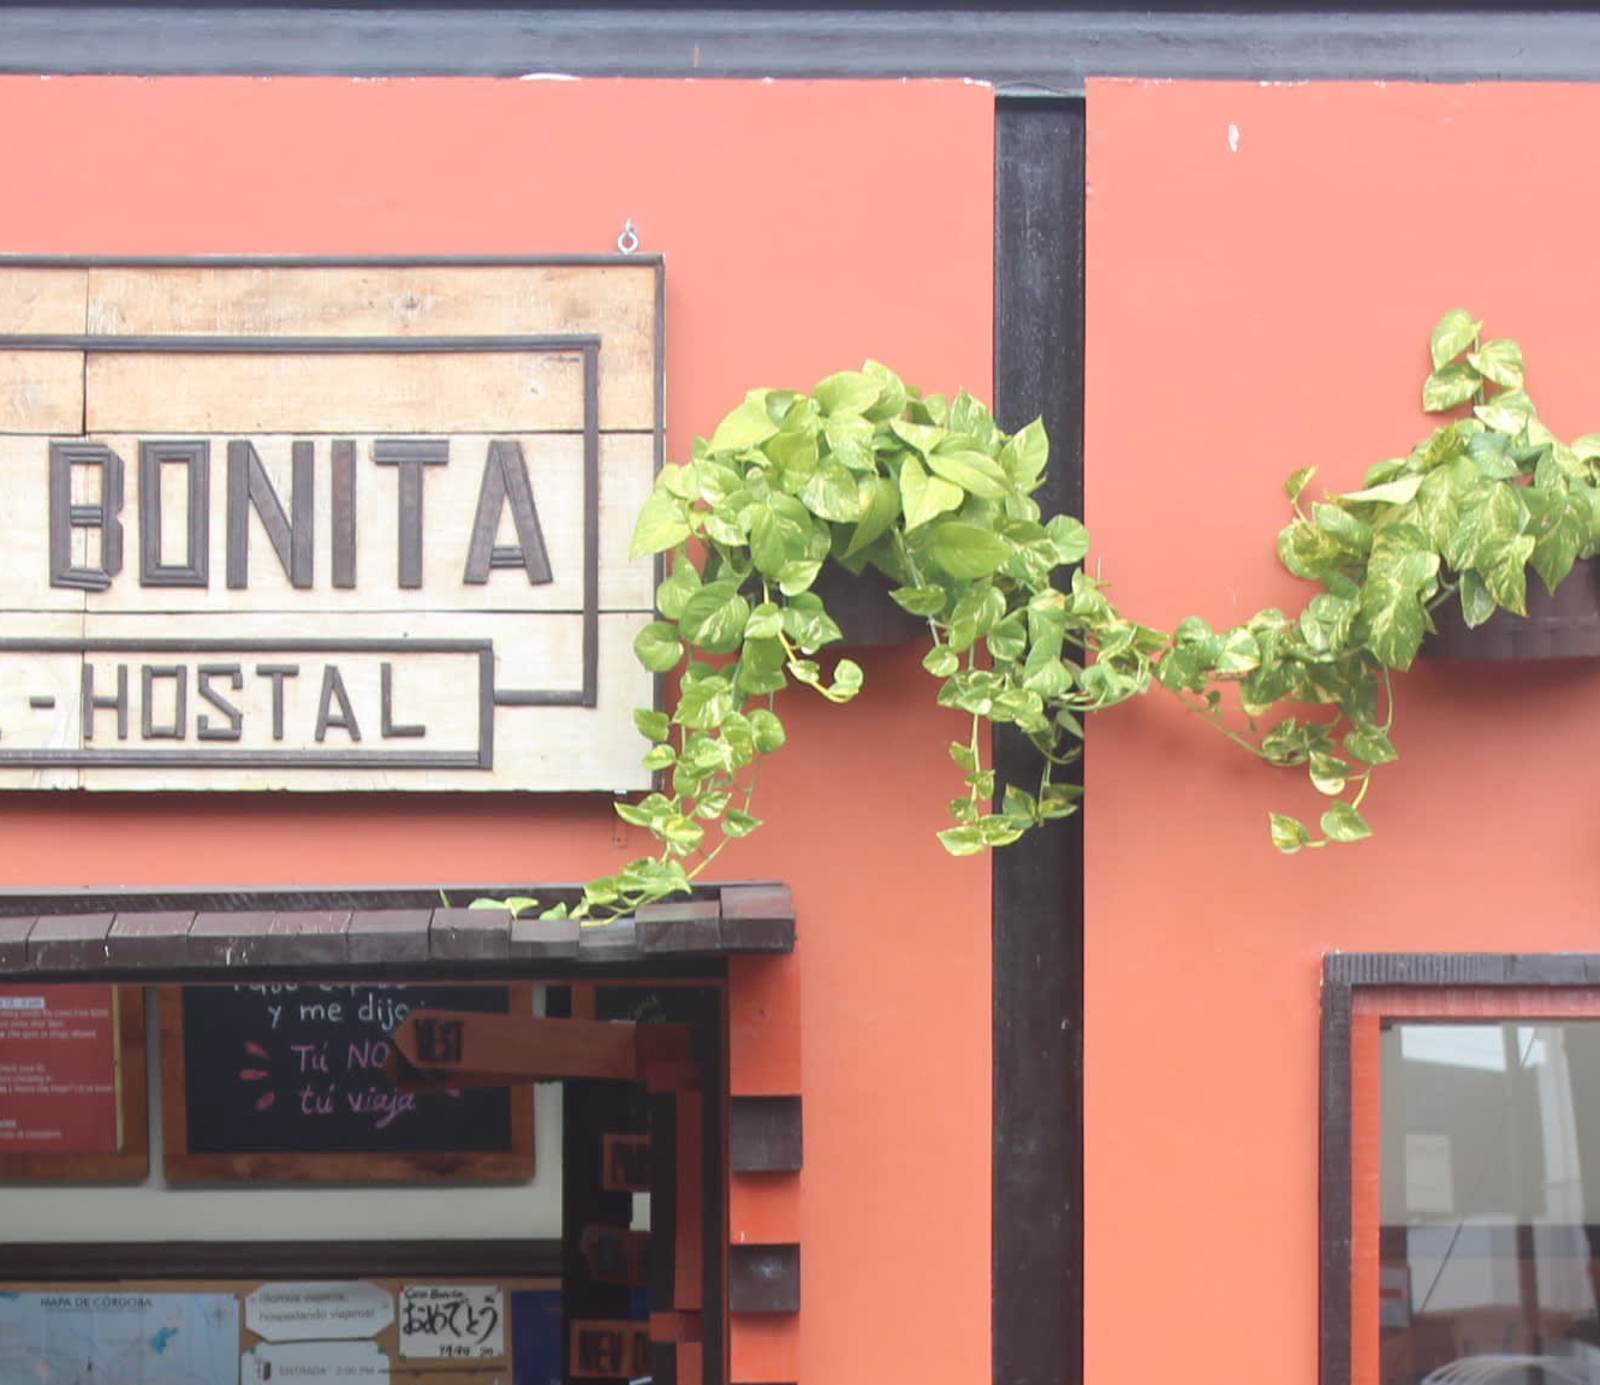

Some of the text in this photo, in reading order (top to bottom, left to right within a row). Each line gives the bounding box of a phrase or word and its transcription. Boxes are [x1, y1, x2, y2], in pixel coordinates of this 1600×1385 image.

[49, 438, 554, 592] BONITA
[299, 1000, 344, 1023] me
[40, 1295, 73, 1307] MAPA
[75, 1295, 90, 1307] DE
